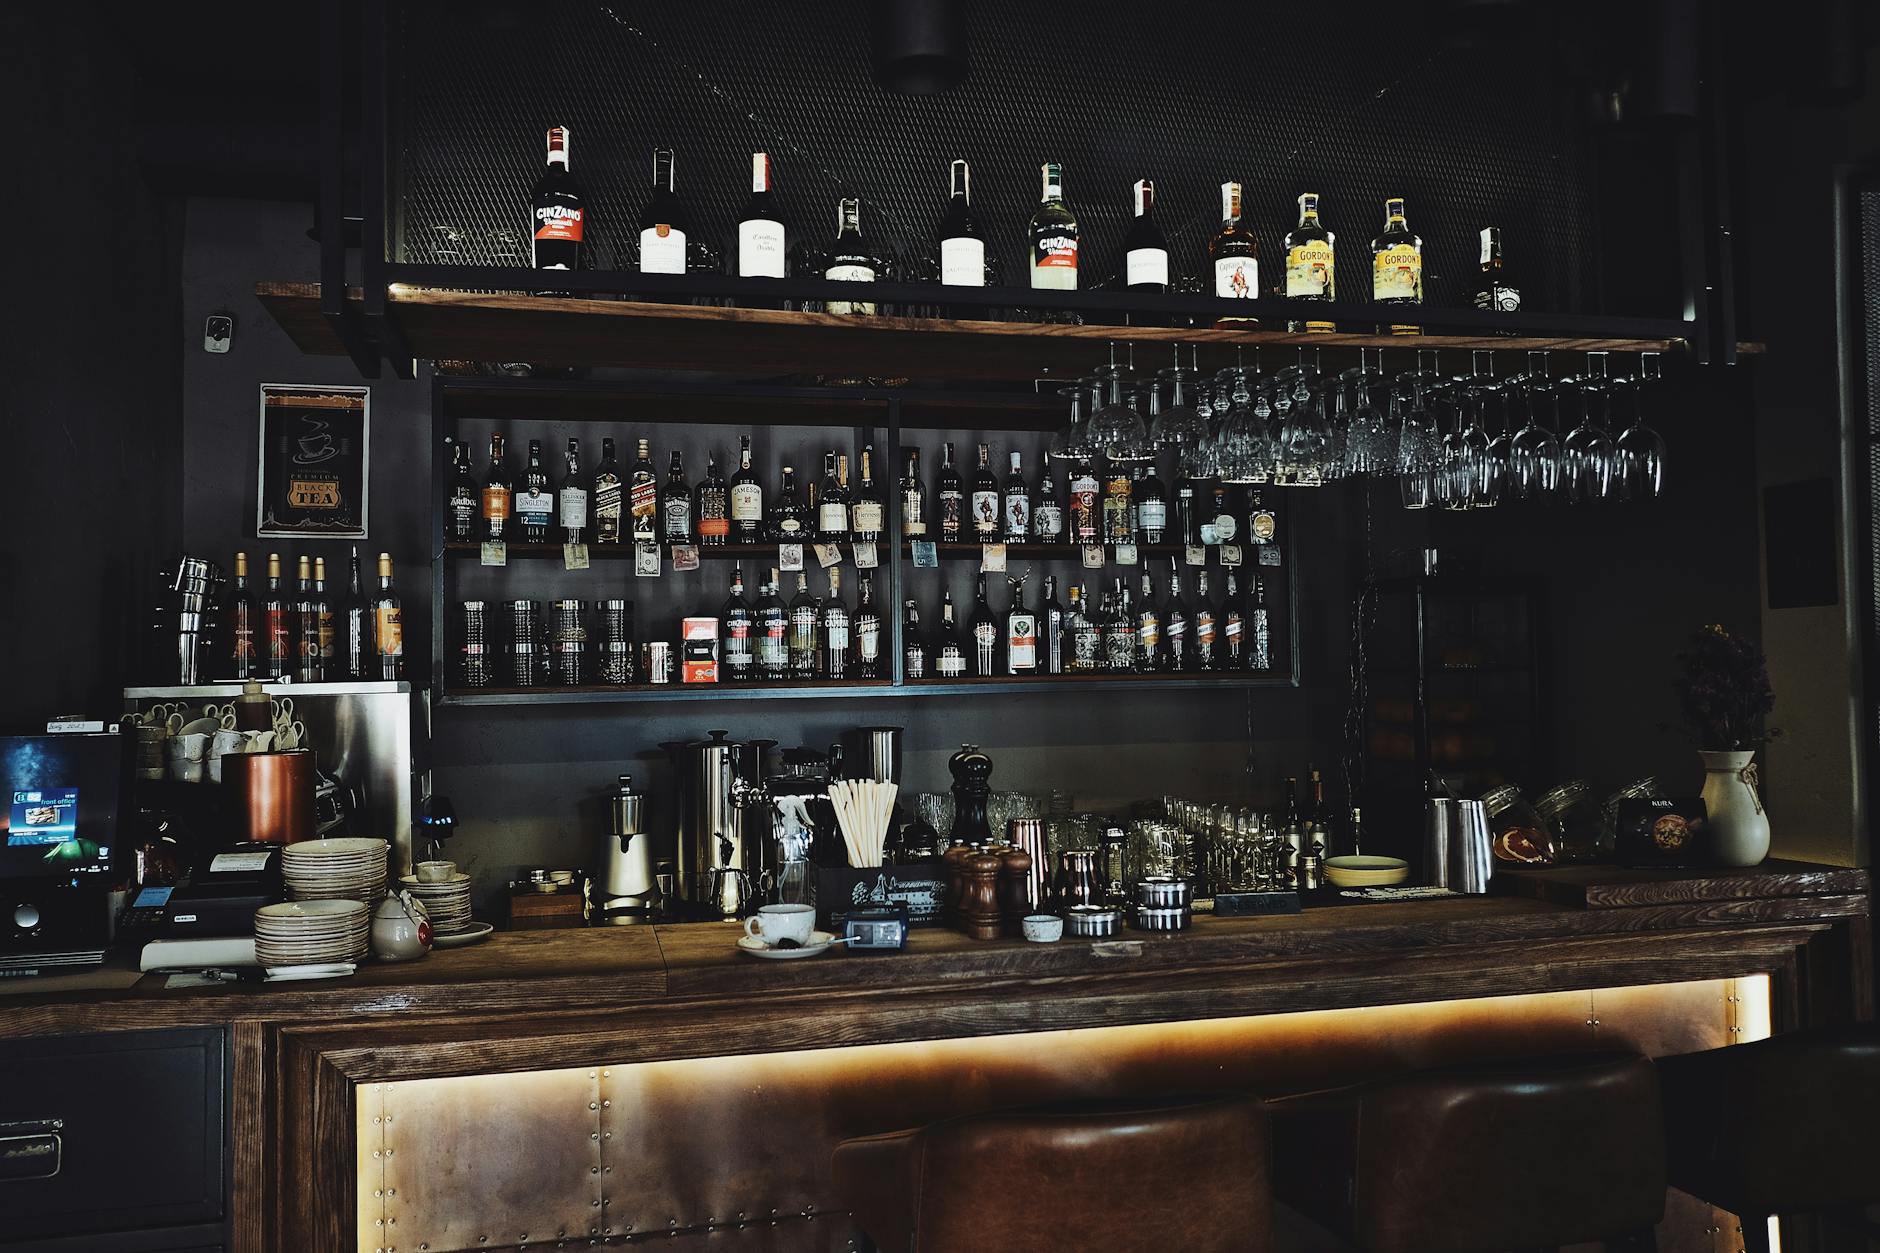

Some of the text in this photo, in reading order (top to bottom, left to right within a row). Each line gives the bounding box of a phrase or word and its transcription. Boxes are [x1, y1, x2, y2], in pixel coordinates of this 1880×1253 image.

[536, 205, 581, 221] CINZANO
[1039, 236, 1077, 250] CINZANO
[641, 489, 656, 497] LABEL
[734, 486, 760, 495] JAMESON
[297, 493, 333, 505] TEA
[519, 498, 549, 507] SINGLETON
[521, 516, 529, 525] 12
[726, 619, 751, 627] CINZANO
